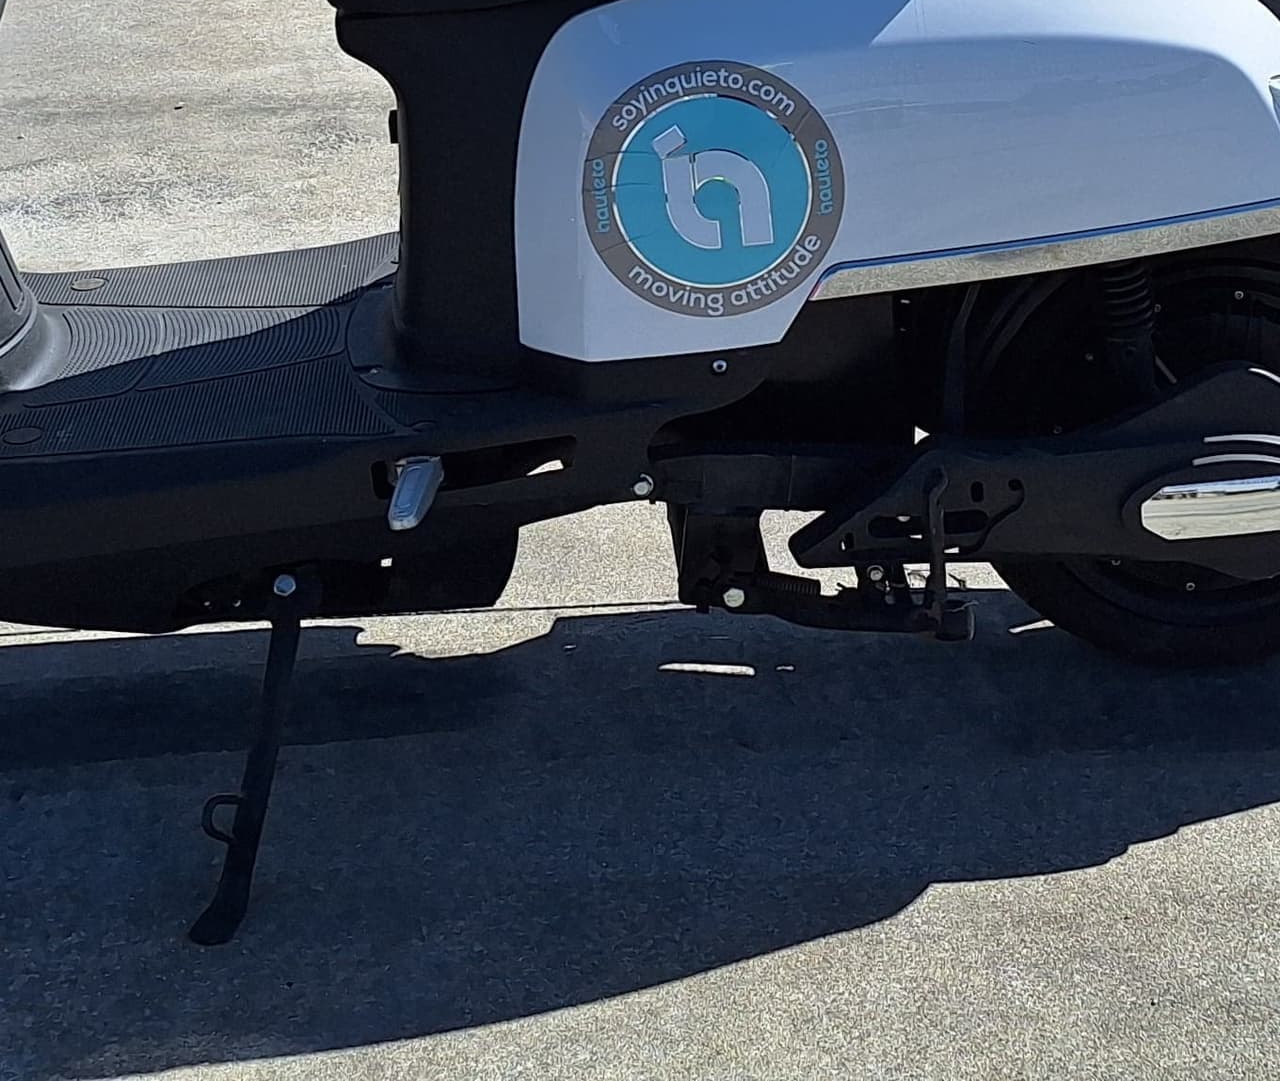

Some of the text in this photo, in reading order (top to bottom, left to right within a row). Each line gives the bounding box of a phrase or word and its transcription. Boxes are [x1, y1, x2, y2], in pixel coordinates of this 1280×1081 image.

[612, 66, 796, 131] soyinquieto.com
[628, 234, 822, 316] moving attitude
